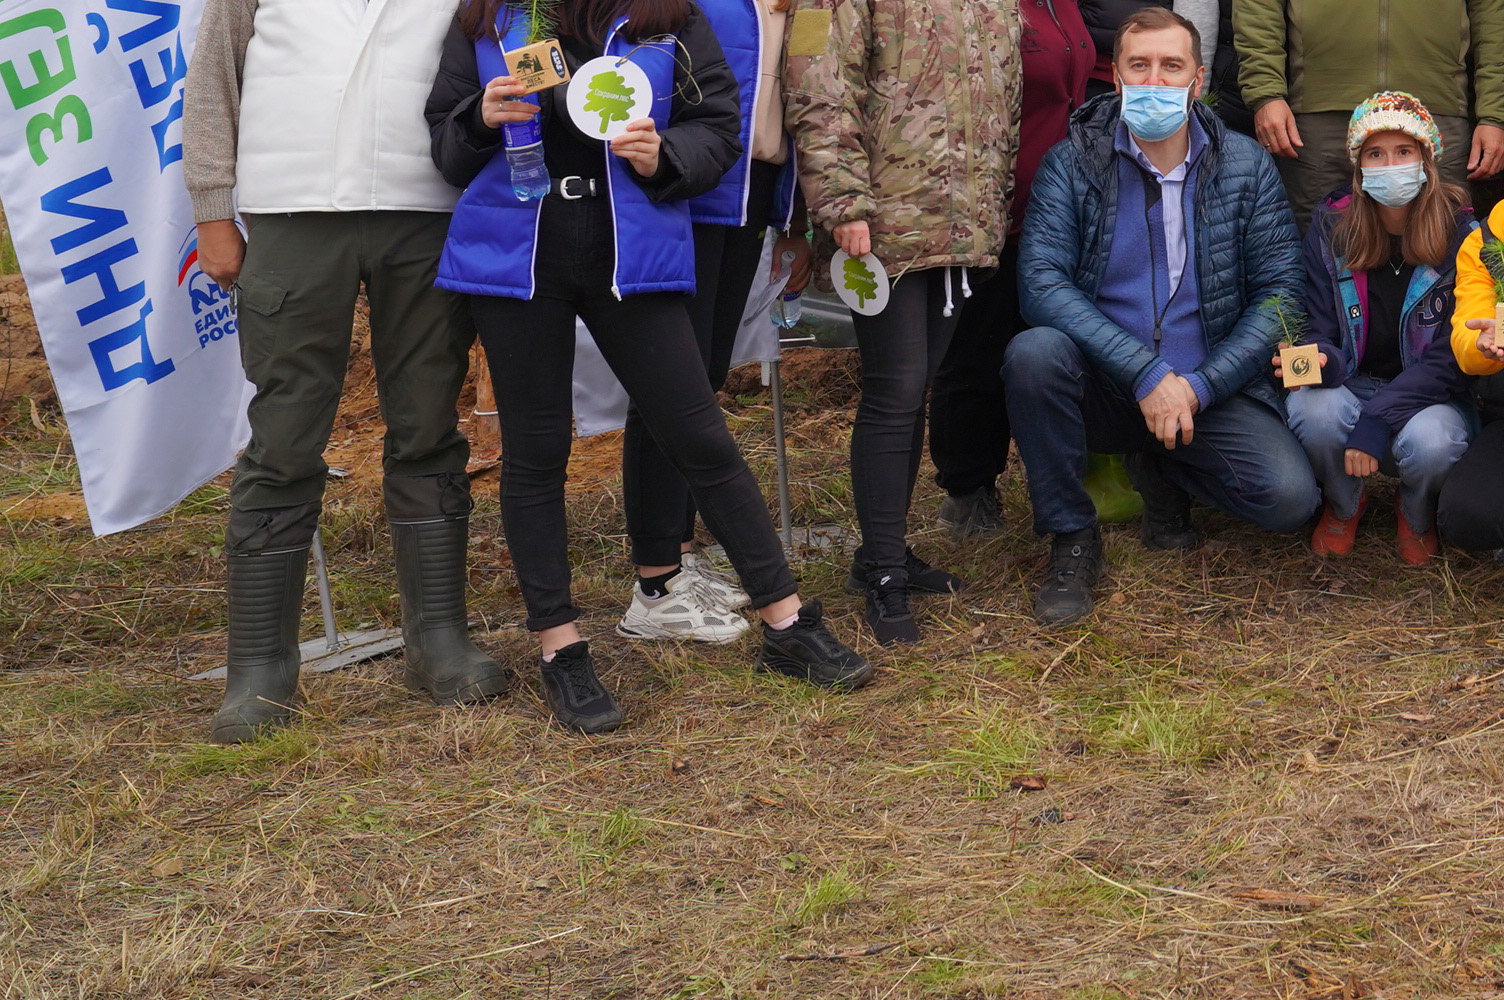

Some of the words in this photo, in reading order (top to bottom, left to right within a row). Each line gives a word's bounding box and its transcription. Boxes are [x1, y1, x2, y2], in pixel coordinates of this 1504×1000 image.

[40, 166, 175, 392] ДНИ
[194, 304, 238, 335] ЕДИ
[199, 317, 238, 349] РОС
